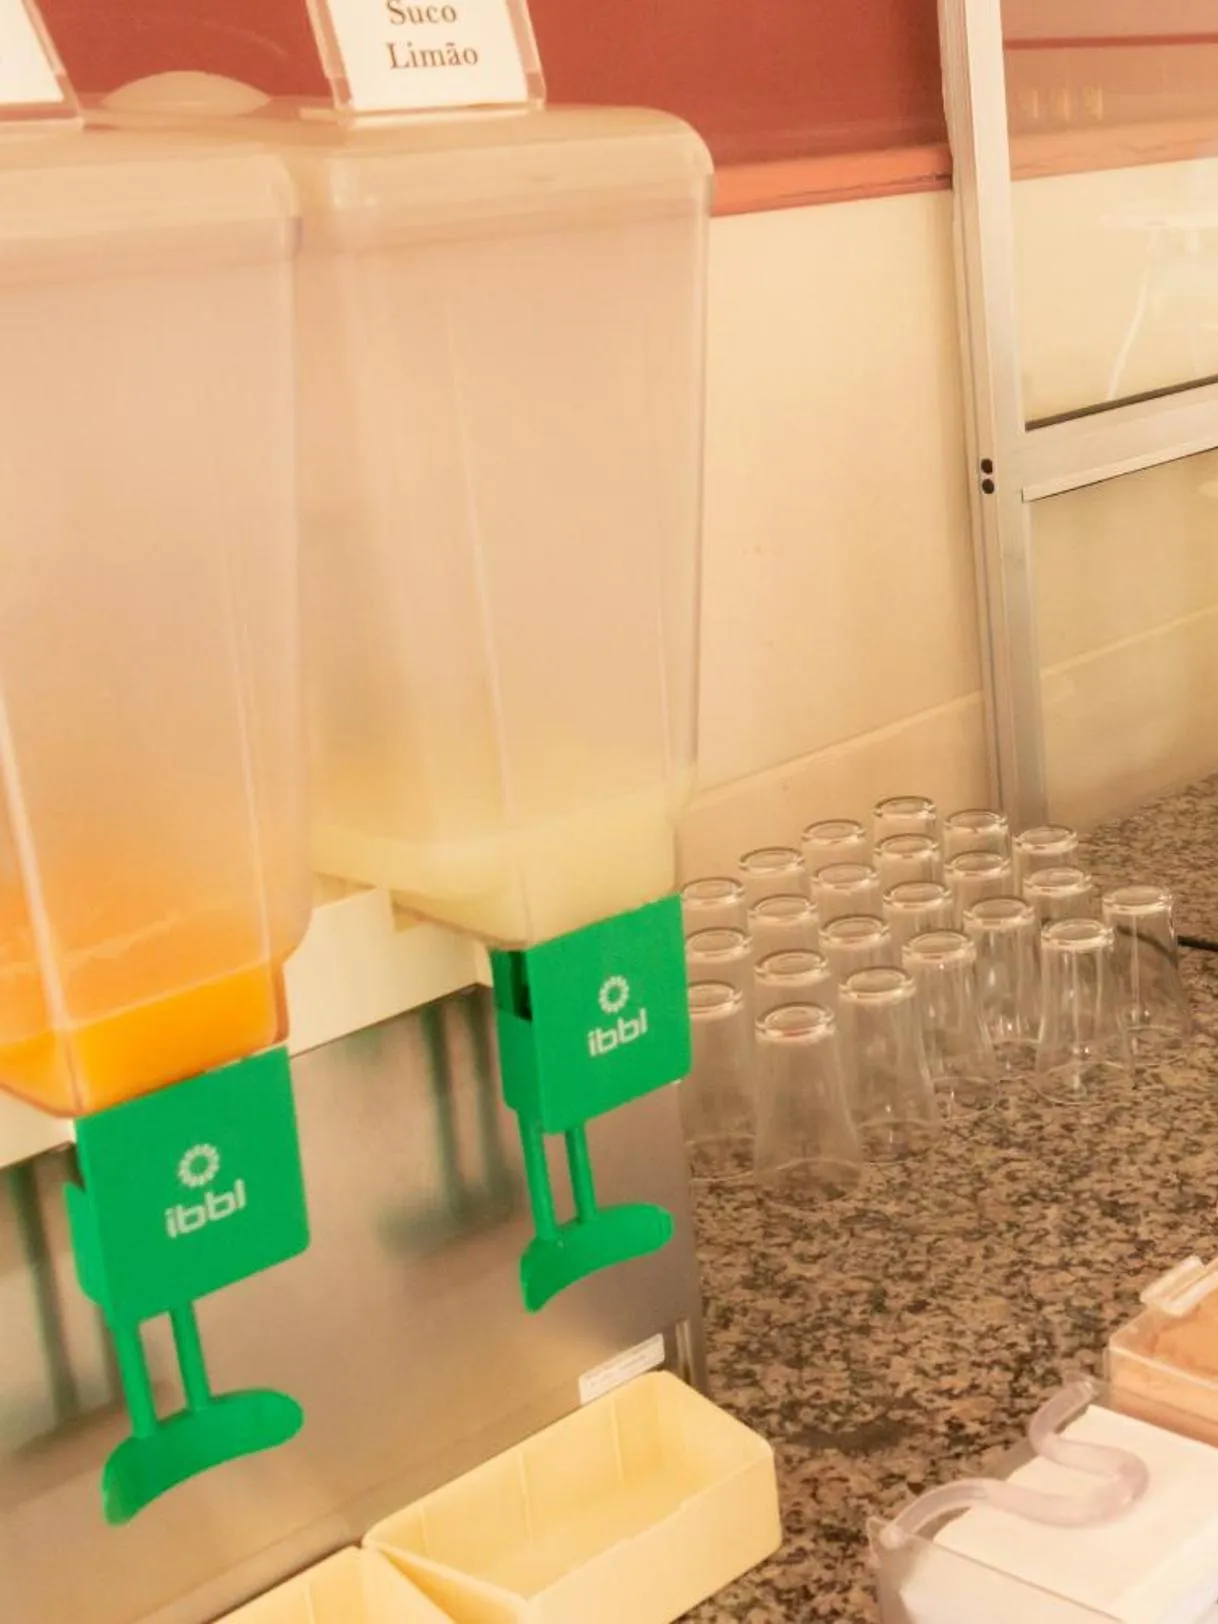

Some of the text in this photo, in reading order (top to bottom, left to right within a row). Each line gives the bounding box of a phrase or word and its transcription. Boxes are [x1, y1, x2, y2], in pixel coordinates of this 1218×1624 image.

[386, 0, 457, 25] Suco
[386, 41, 478, 69] Limão
[587, 1008, 648, 1056] ibbl
[165, 1178, 245, 1238] ibbl
